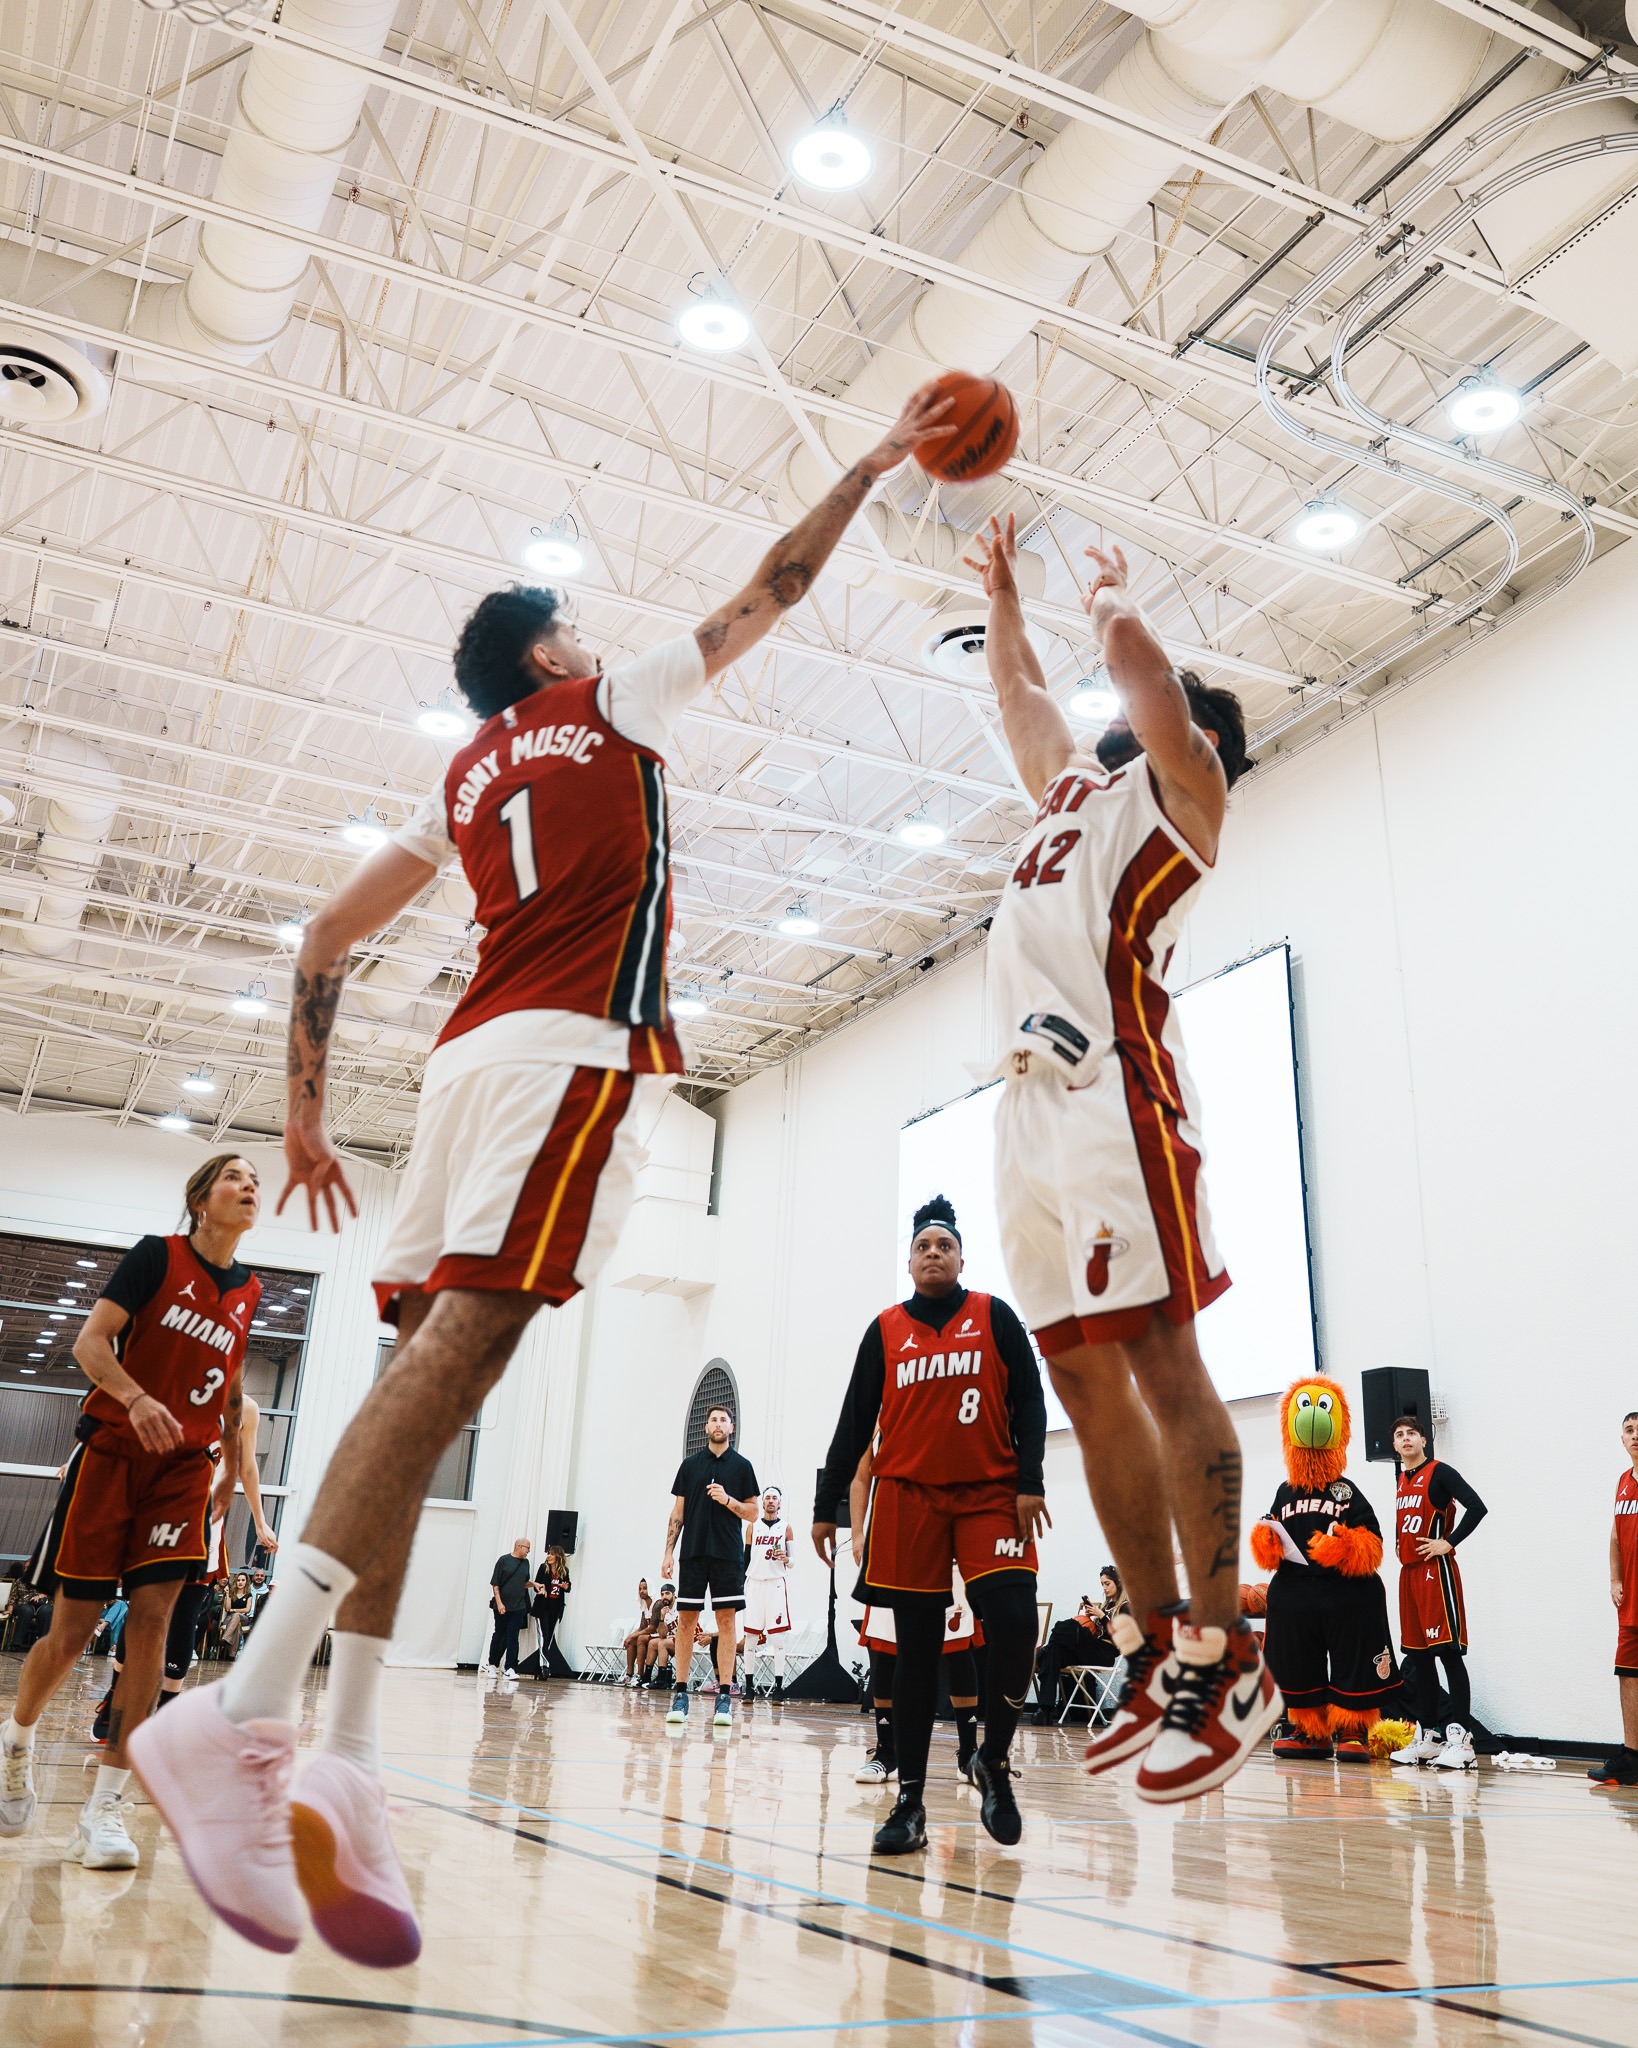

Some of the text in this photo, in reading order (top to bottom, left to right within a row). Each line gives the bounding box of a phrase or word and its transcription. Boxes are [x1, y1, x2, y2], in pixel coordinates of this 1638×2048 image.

[453, 724, 604, 825] SONY MUSIC
[500, 785, 541, 904] 1
[1013, 829, 1082, 890] 42
[160, 1303, 236, 1356] MIAMI
[189, 1366, 225, 1406] 3
[896, 1350, 982, 1389] MIAMI
[957, 1387, 981, 1425] 8
[1401, 1514, 1423, 1534] 20
[1614, 1499, 1638, 1516] MIA
[755, 1535, 783, 1546] HEAT
